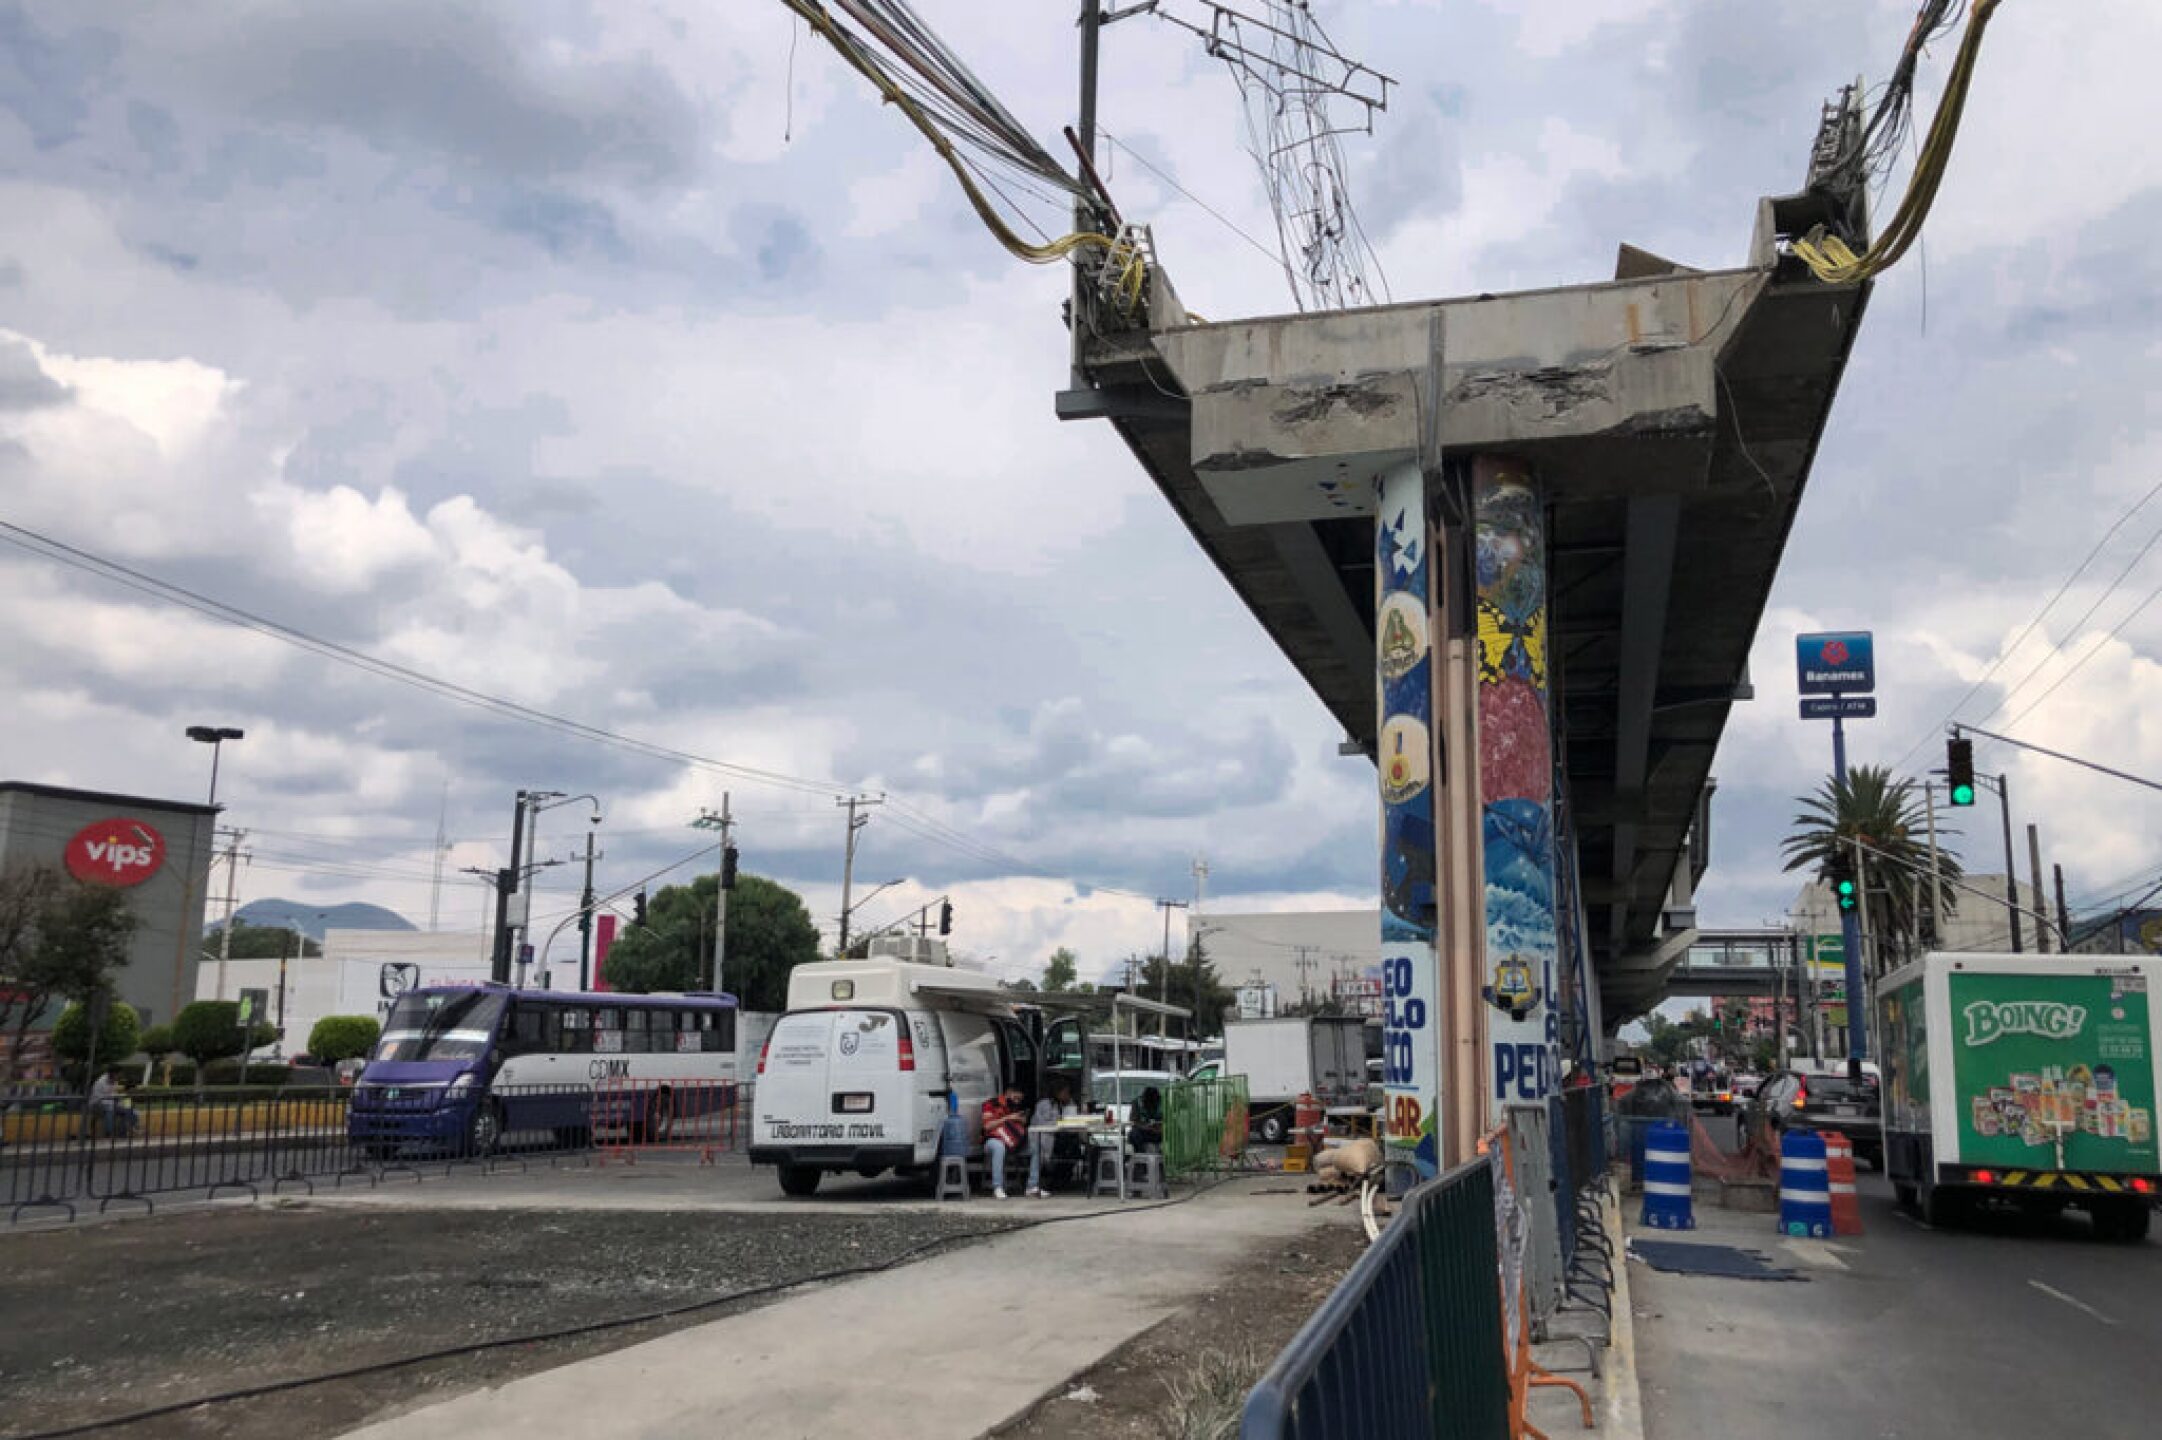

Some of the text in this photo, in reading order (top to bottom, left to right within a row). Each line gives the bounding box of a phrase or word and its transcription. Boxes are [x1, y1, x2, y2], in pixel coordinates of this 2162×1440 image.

[85, 835, 152, 872] vips
[1965, 1001, 2086, 1045] BOING!
[589, 1060, 630, 1079] CDMX
